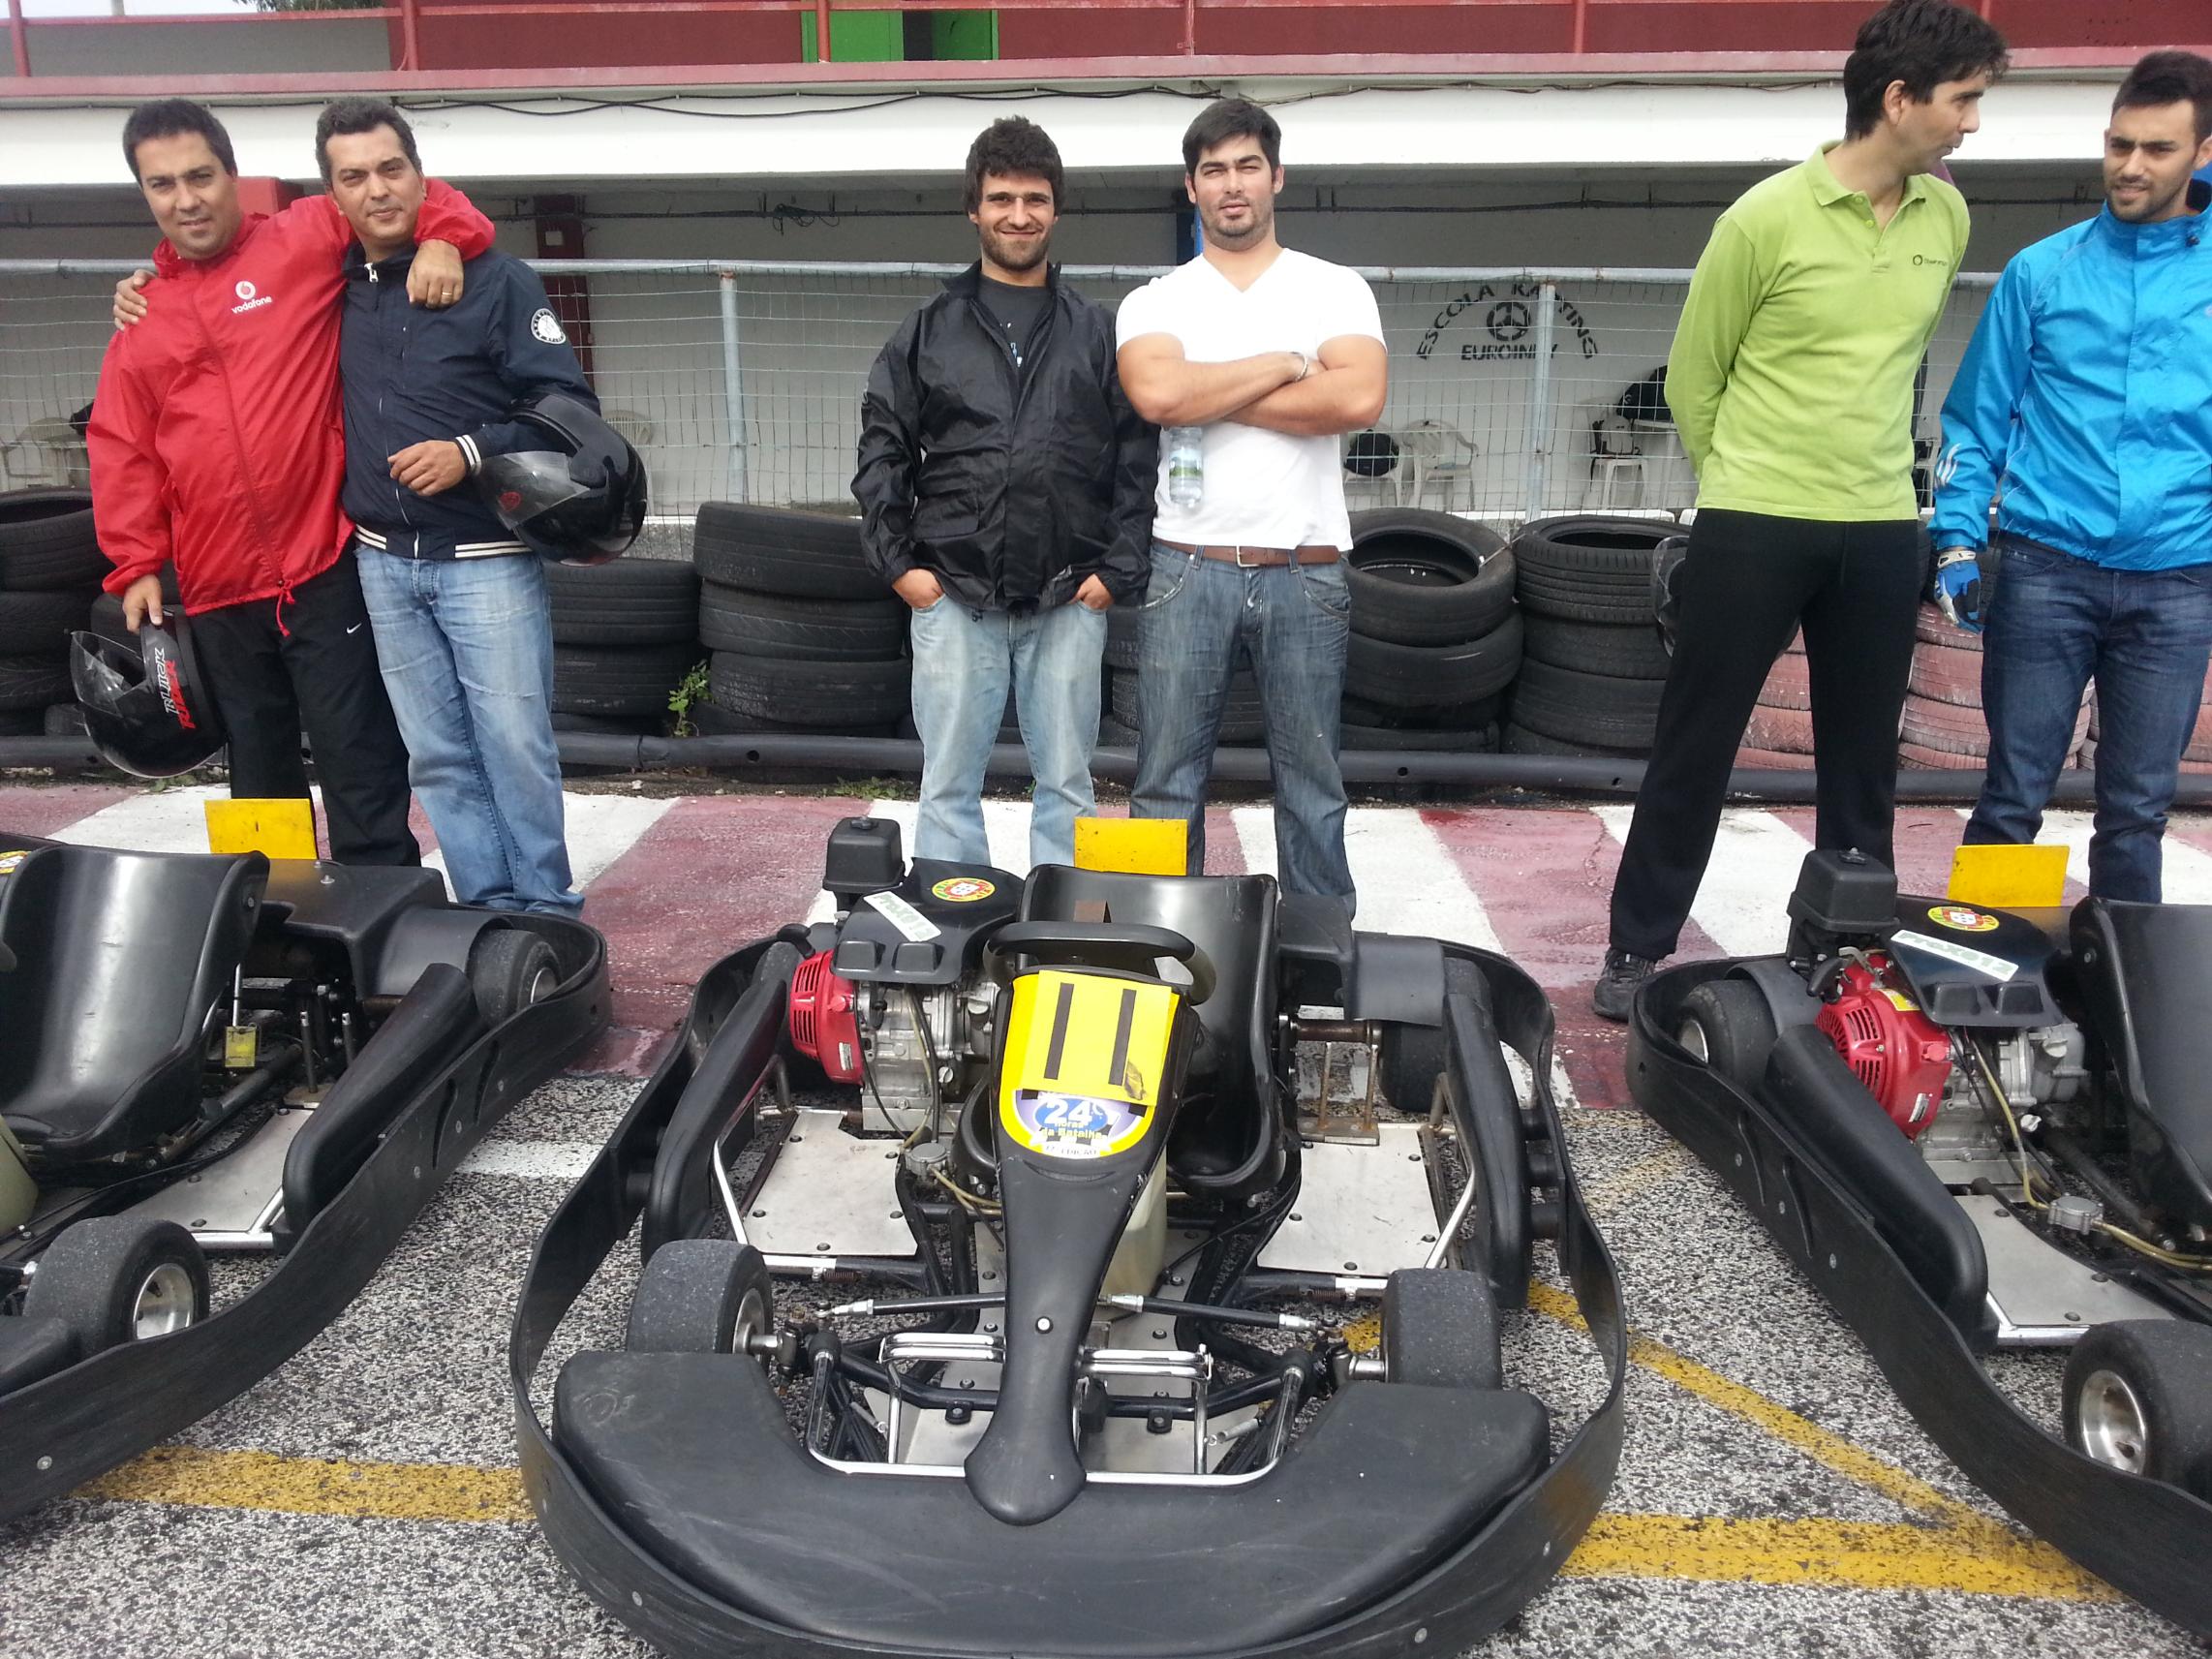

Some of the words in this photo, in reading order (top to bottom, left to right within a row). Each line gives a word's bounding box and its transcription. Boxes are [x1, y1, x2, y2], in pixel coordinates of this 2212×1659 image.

[230, 296, 272, 314] vodafone
[1417, 284, 1495, 361] ESCOLA
[1044, 1098, 1093, 1126] 24
